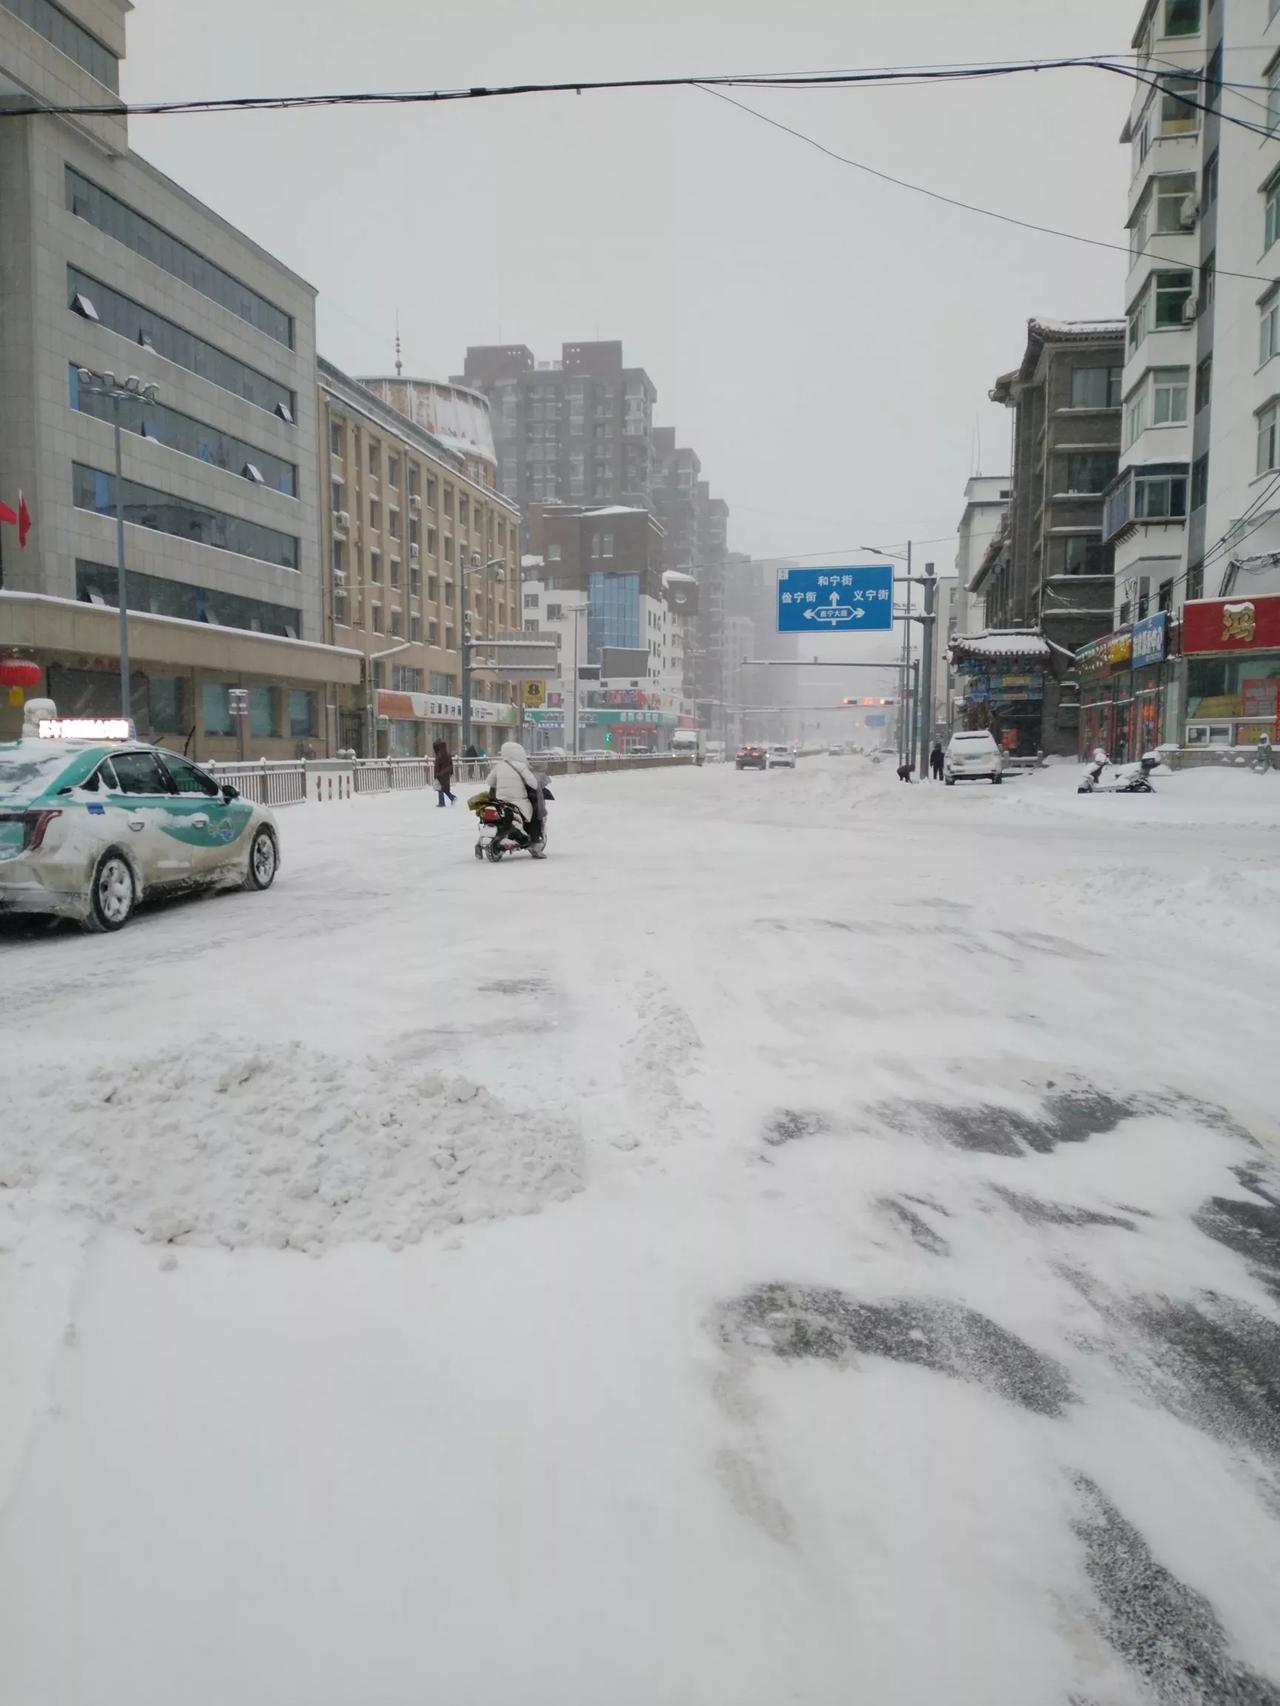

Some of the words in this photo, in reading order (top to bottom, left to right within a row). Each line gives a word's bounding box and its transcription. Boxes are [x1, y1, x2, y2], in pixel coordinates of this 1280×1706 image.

[817, 575, 852, 586] 和宁街
[853, 589, 888, 601] 义宁街
